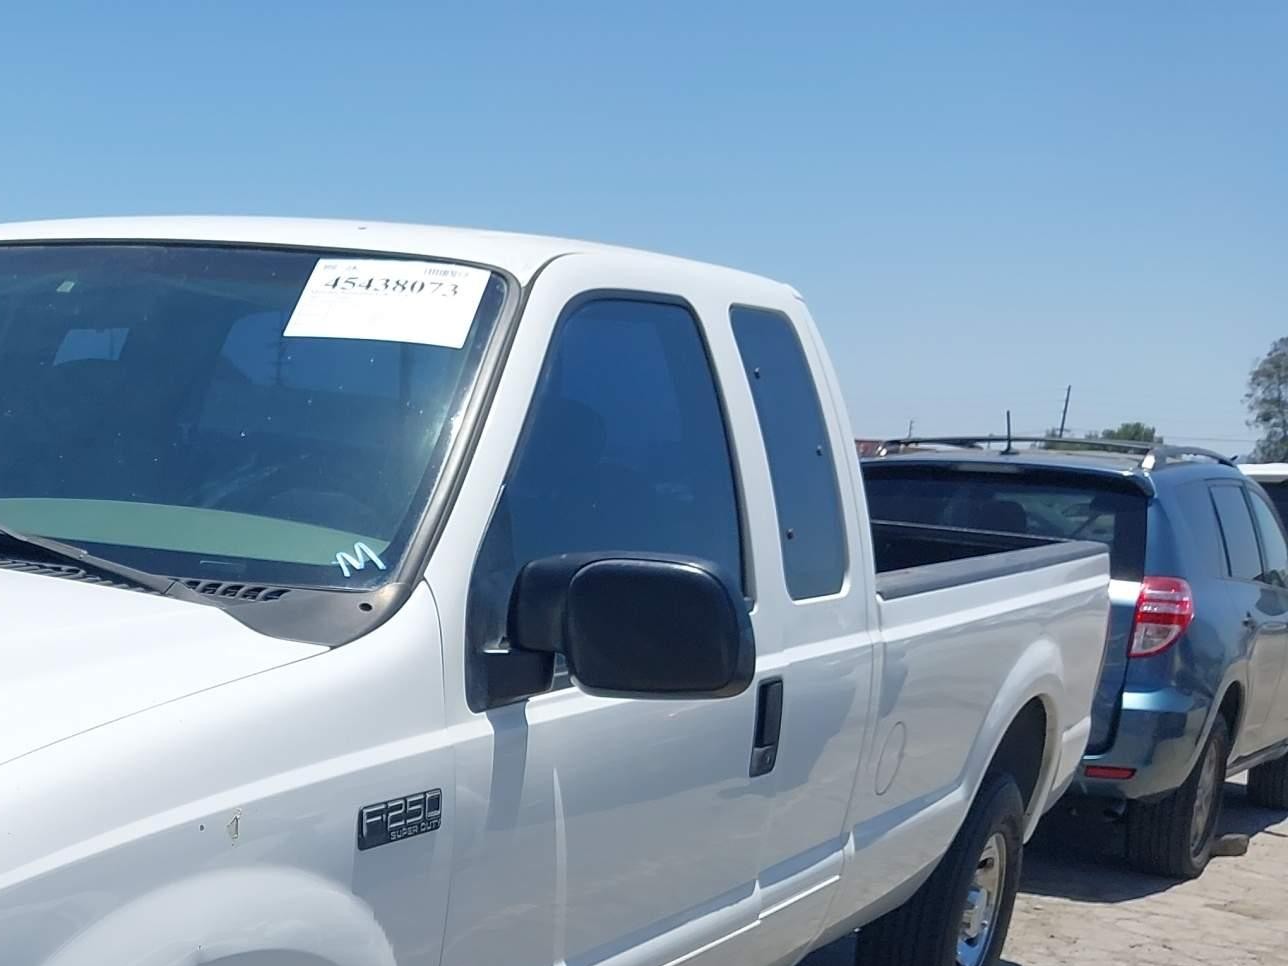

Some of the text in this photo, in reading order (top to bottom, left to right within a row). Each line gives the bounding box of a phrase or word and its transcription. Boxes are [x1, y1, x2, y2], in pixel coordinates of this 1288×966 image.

[323, 274, 460, 299] 45438073
[390, 820, 441, 841] SUPER DUTY
